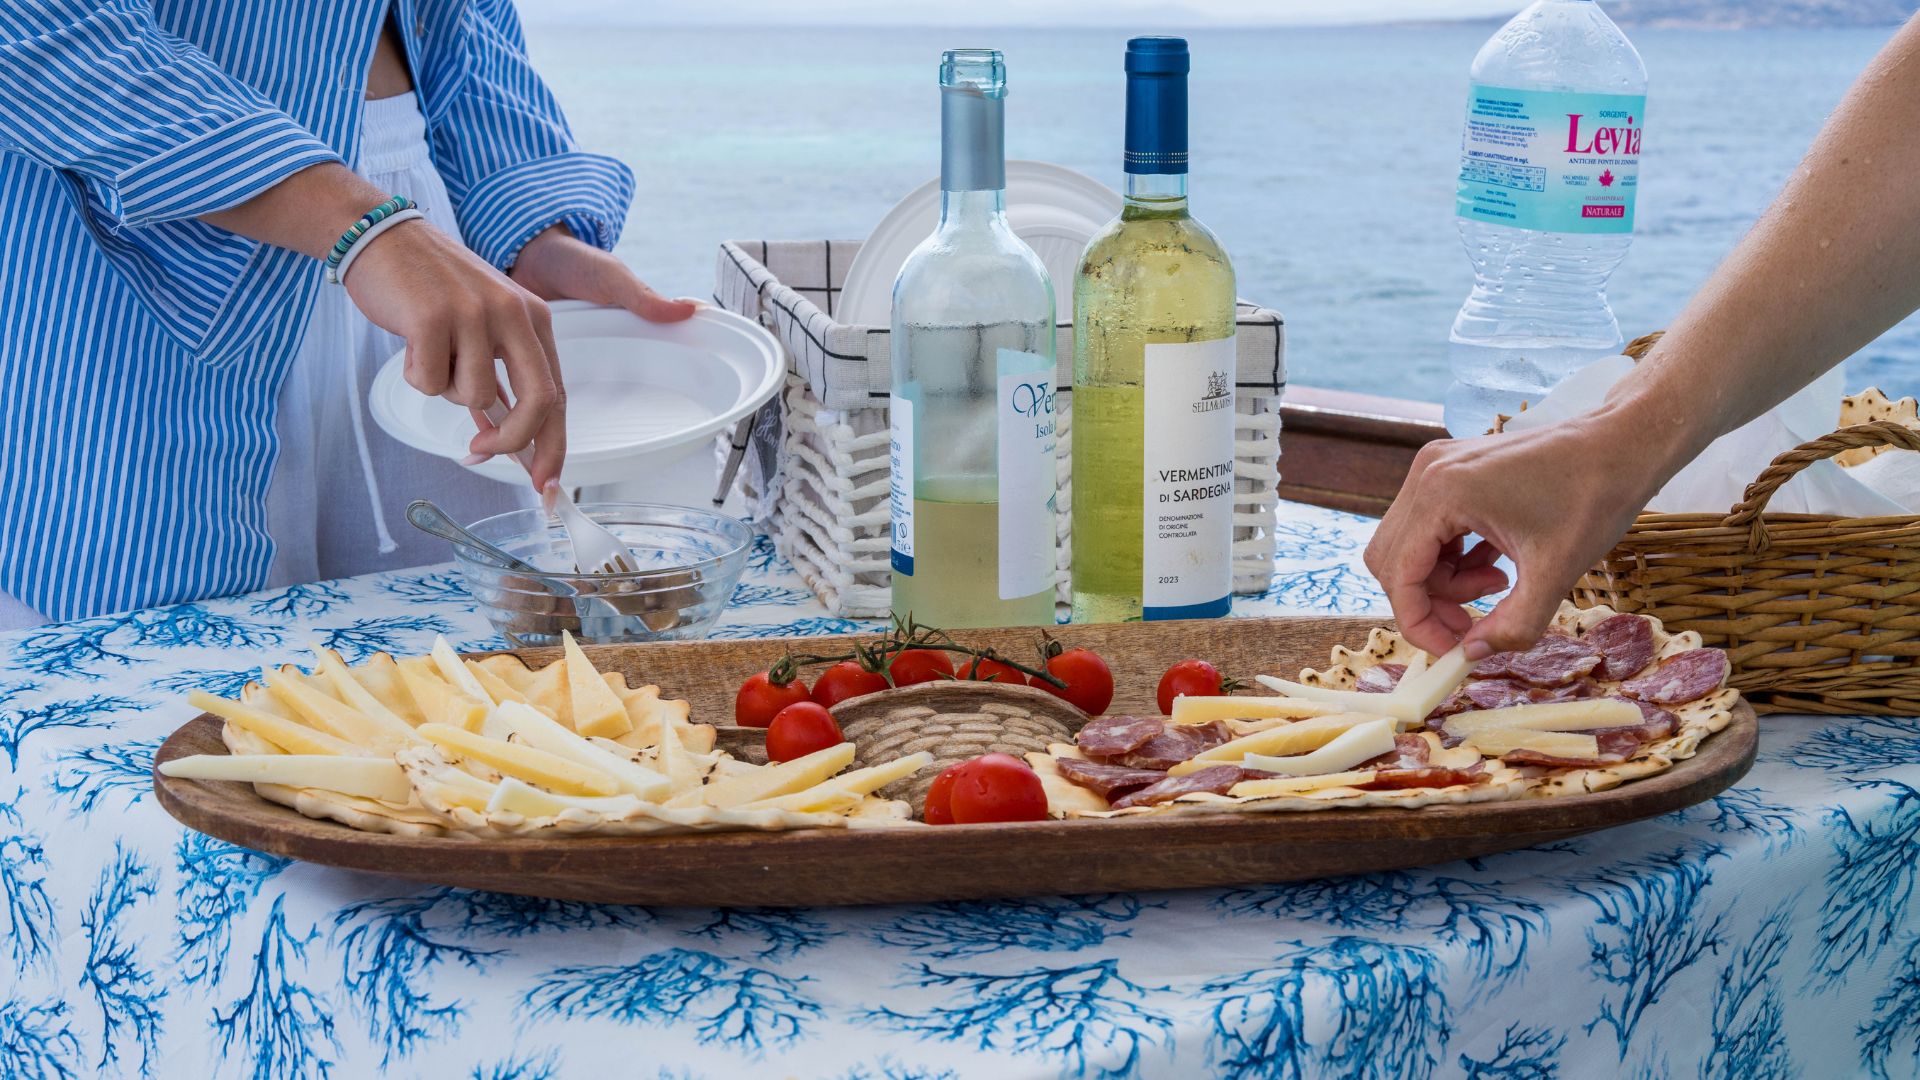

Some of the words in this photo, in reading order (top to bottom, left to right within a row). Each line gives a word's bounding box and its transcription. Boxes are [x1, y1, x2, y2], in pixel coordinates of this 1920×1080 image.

[1563, 114, 1641, 155] Levia
[1586, 207, 1622, 216] NATURALE
[1159, 460, 1232, 482] VERMENTINO
[1160, 494, 1170, 503] DI
[1173, 481, 1231, 502] SARDEGNA
[1159, 513, 1204, 522] DENOMINAZIONE
[1159, 531, 1197, 539] CONTROLLATA
[1159, 576, 1179, 584] 2023
